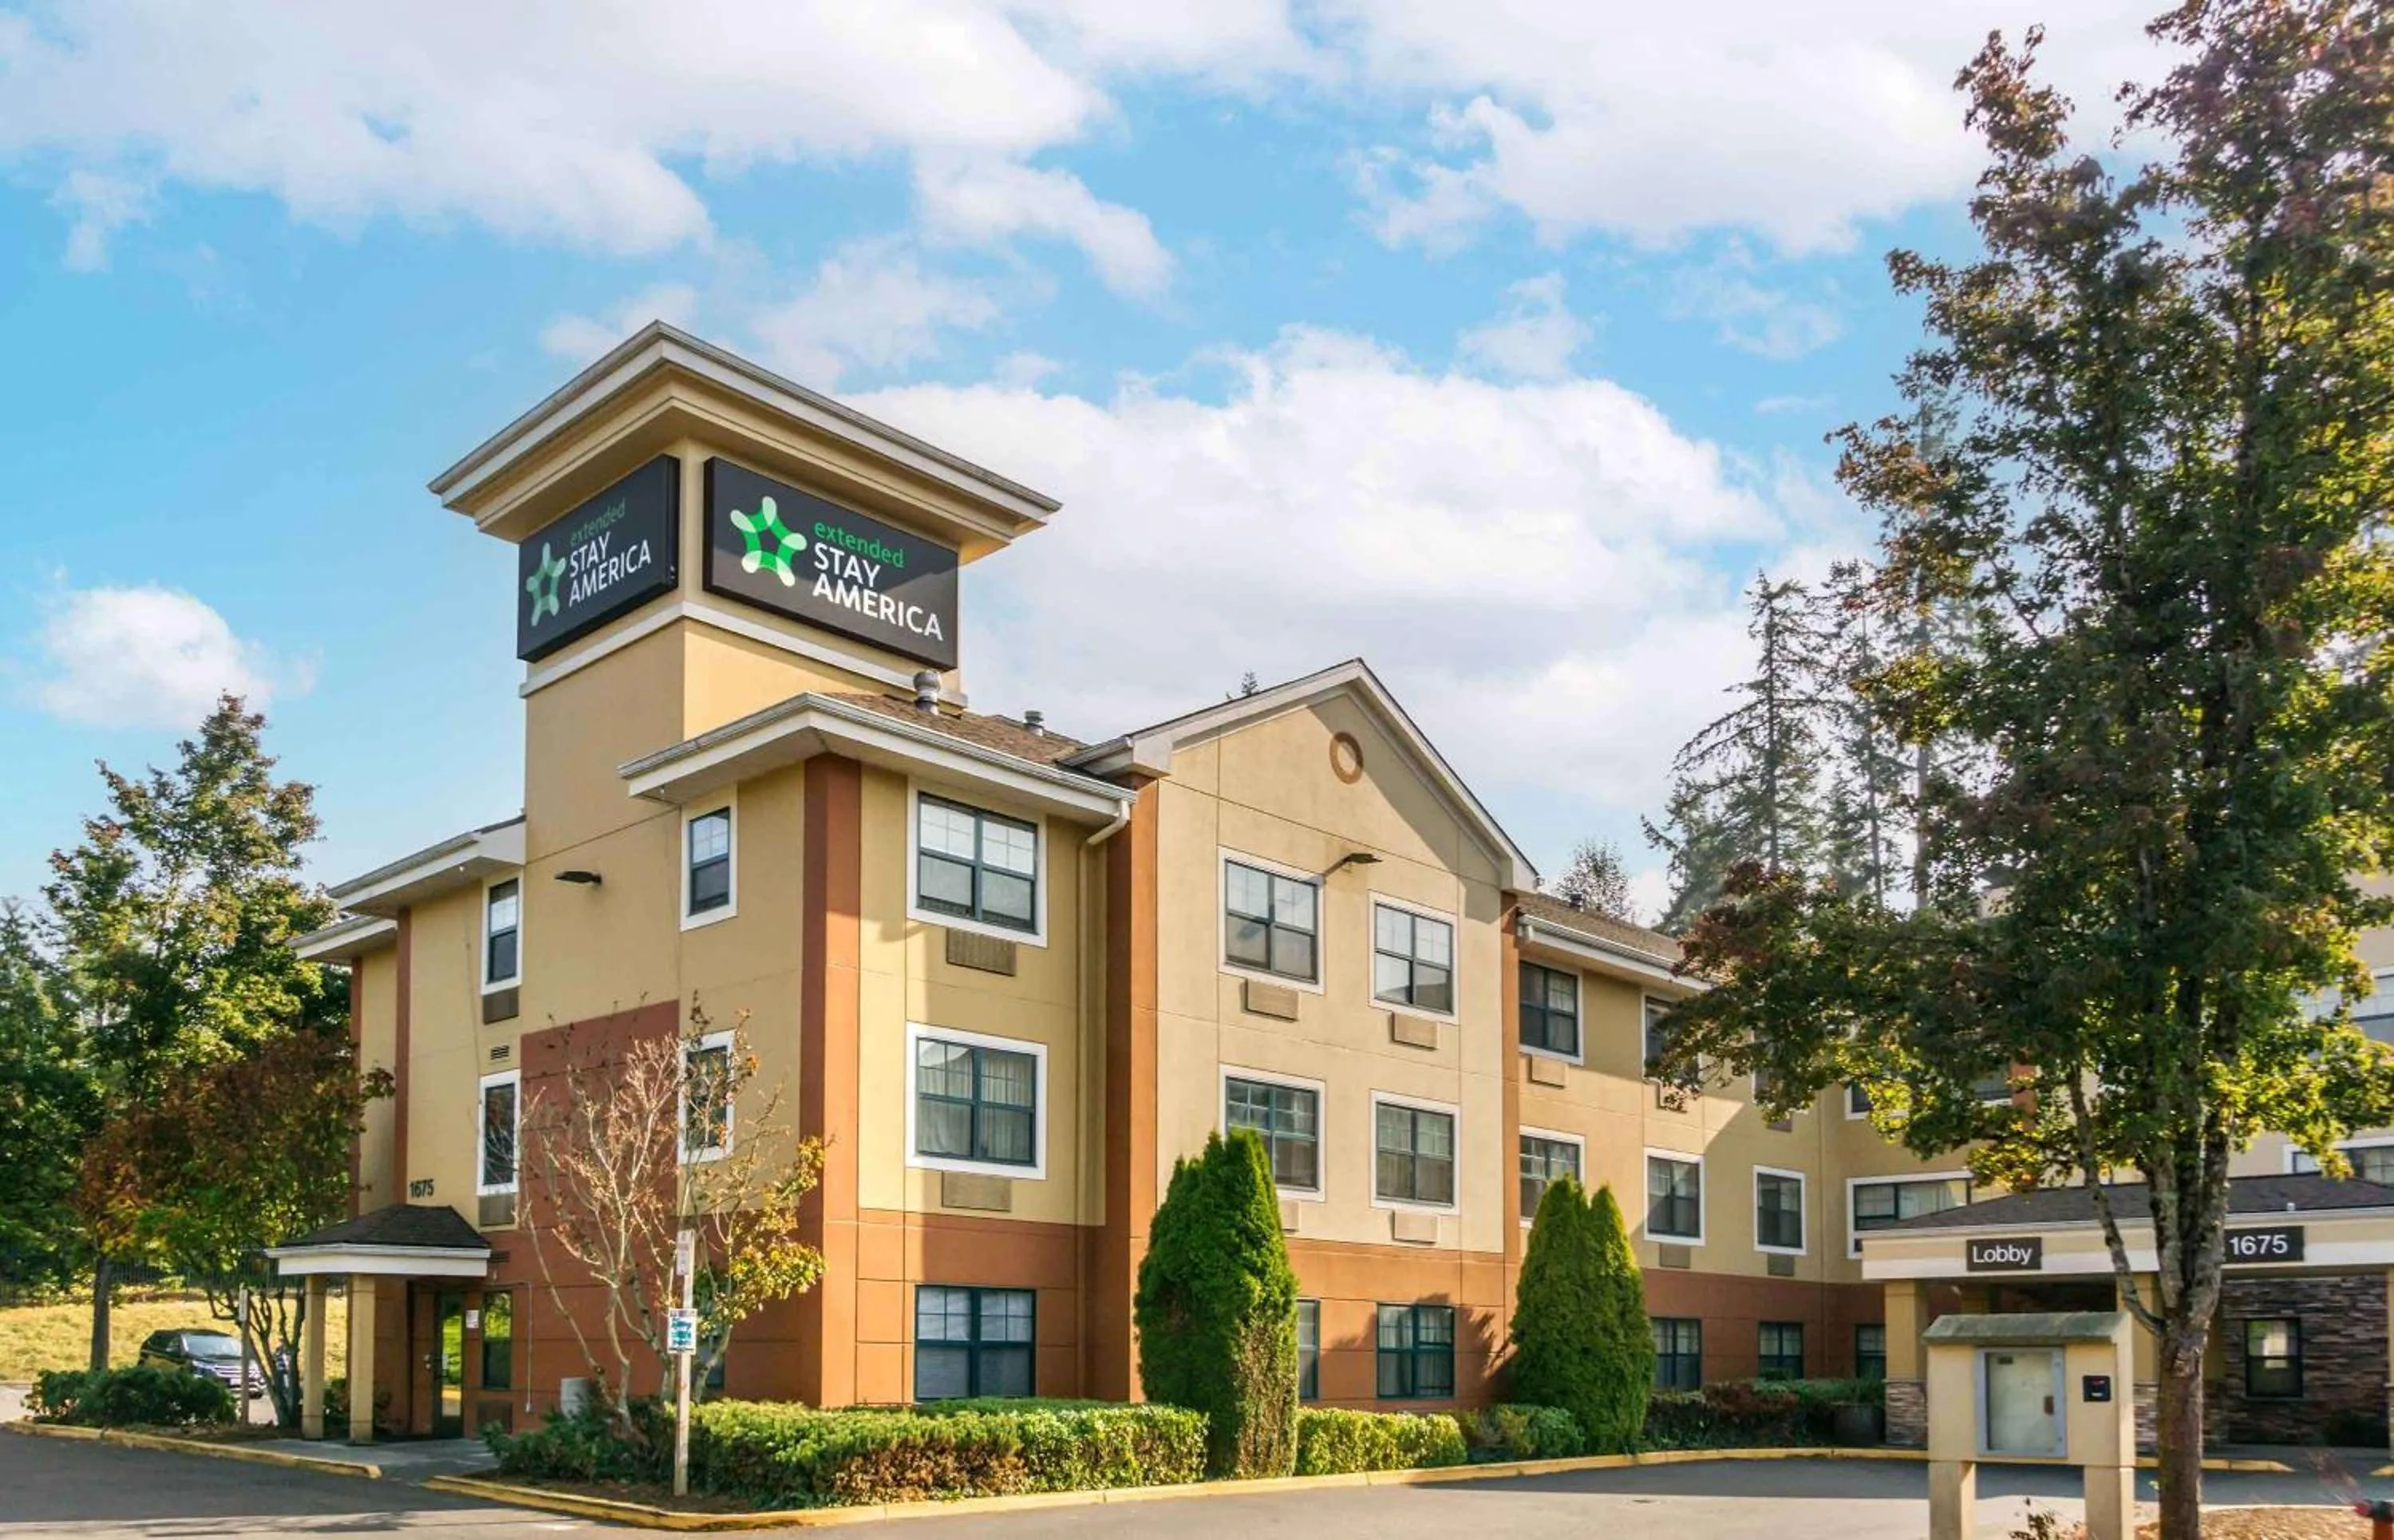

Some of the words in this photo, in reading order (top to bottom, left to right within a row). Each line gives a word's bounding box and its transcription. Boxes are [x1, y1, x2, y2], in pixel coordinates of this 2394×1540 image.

[570, 498, 626, 545] extended
[814, 522, 904, 567] extended
[568, 539, 652, 607] AMERICA
[569, 531, 611, 578] STAY
[813, 542, 881, 588] STAY
[812, 573, 944, 642] AMERICA
[409, 1179, 434, 1198] 1675
[1973, 1245, 2033, 1266] Lobby
[2230, 1234, 2289, 1255] 1675
